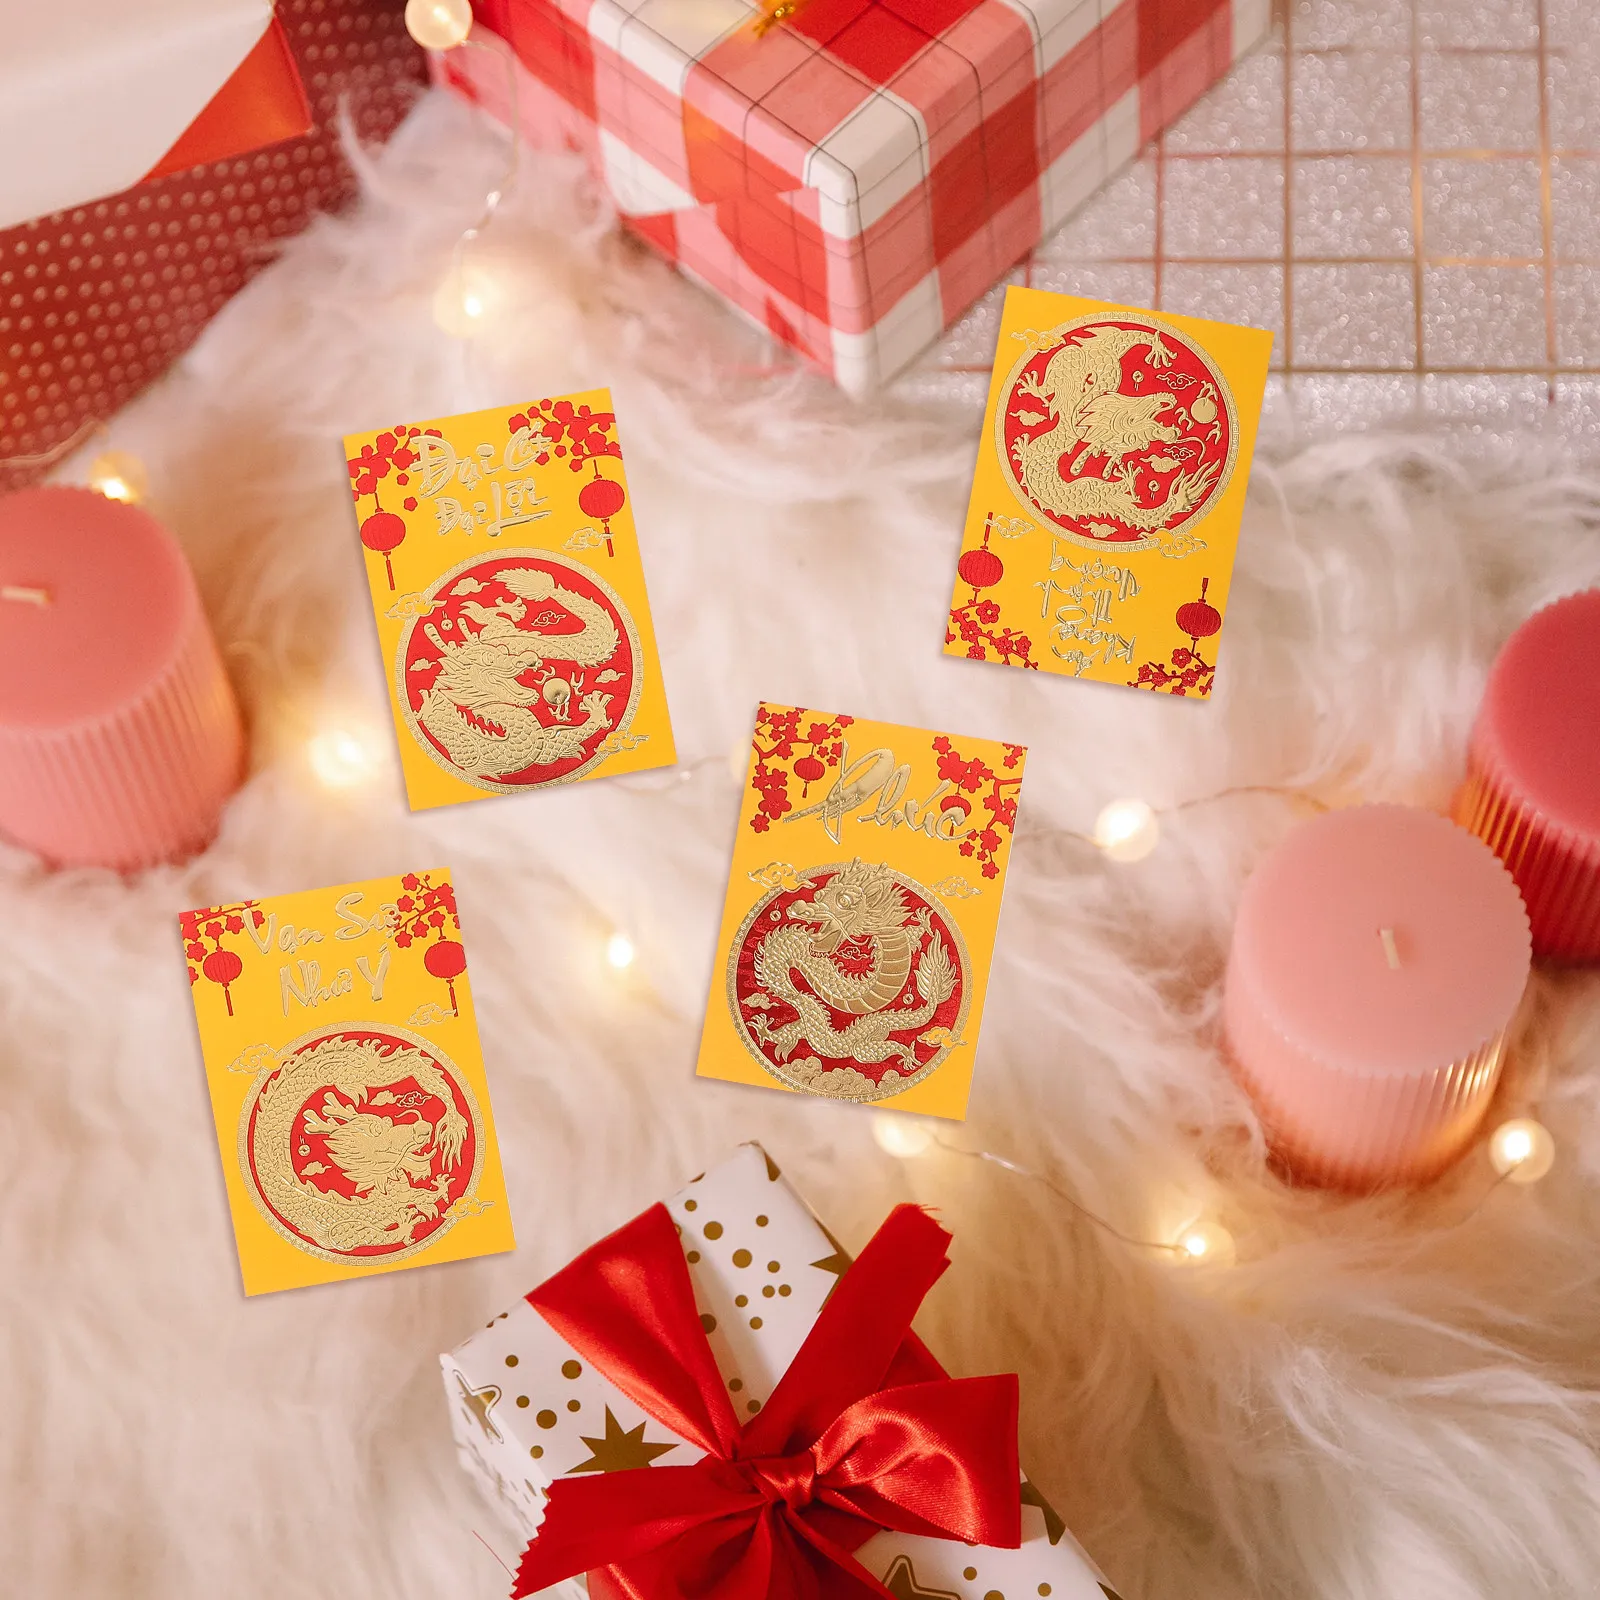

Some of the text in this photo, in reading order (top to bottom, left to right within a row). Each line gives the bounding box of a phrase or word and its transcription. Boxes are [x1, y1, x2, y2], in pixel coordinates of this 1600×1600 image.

[409, 434, 503, 498] Đại
[434, 497, 490, 536] Đại
[1049, 539, 1141, 602] Vượng
[1033, 579, 1113, 627] Thịnh
[782, 738, 976, 845] Phúc
[242, 892, 401, 954] Vạn Sự
[279, 943, 391, 1017] Như Ý
